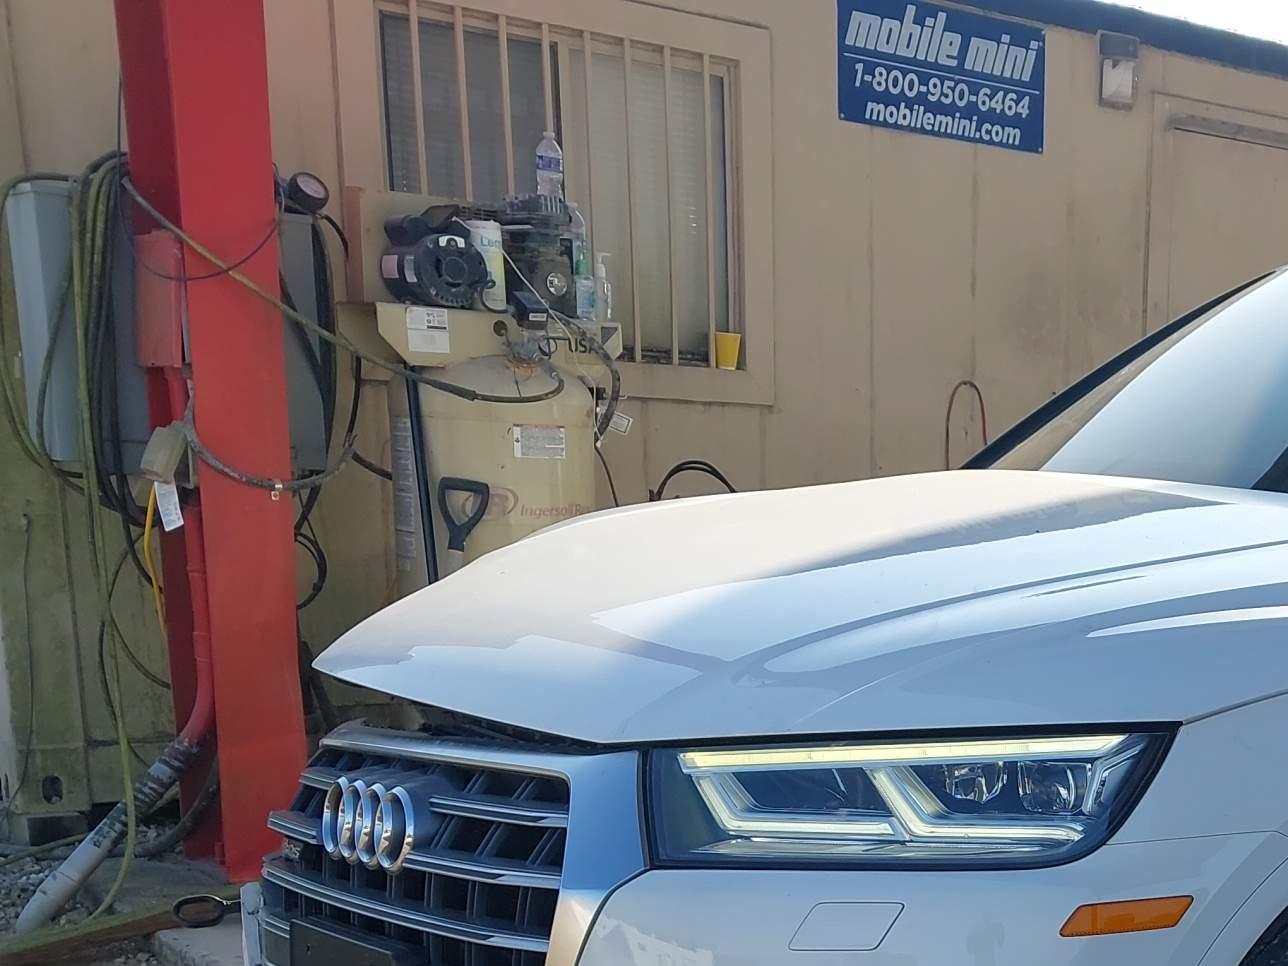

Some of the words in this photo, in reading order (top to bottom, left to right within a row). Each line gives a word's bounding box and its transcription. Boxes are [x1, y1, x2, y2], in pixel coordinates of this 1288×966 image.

[844, 4, 962, 67] mobile
[964, 33, 1039, 82] mini
[854, 62, 1030, 119] 1-800-950-6464
[864, 101, 1021, 146] mobilemini.com
